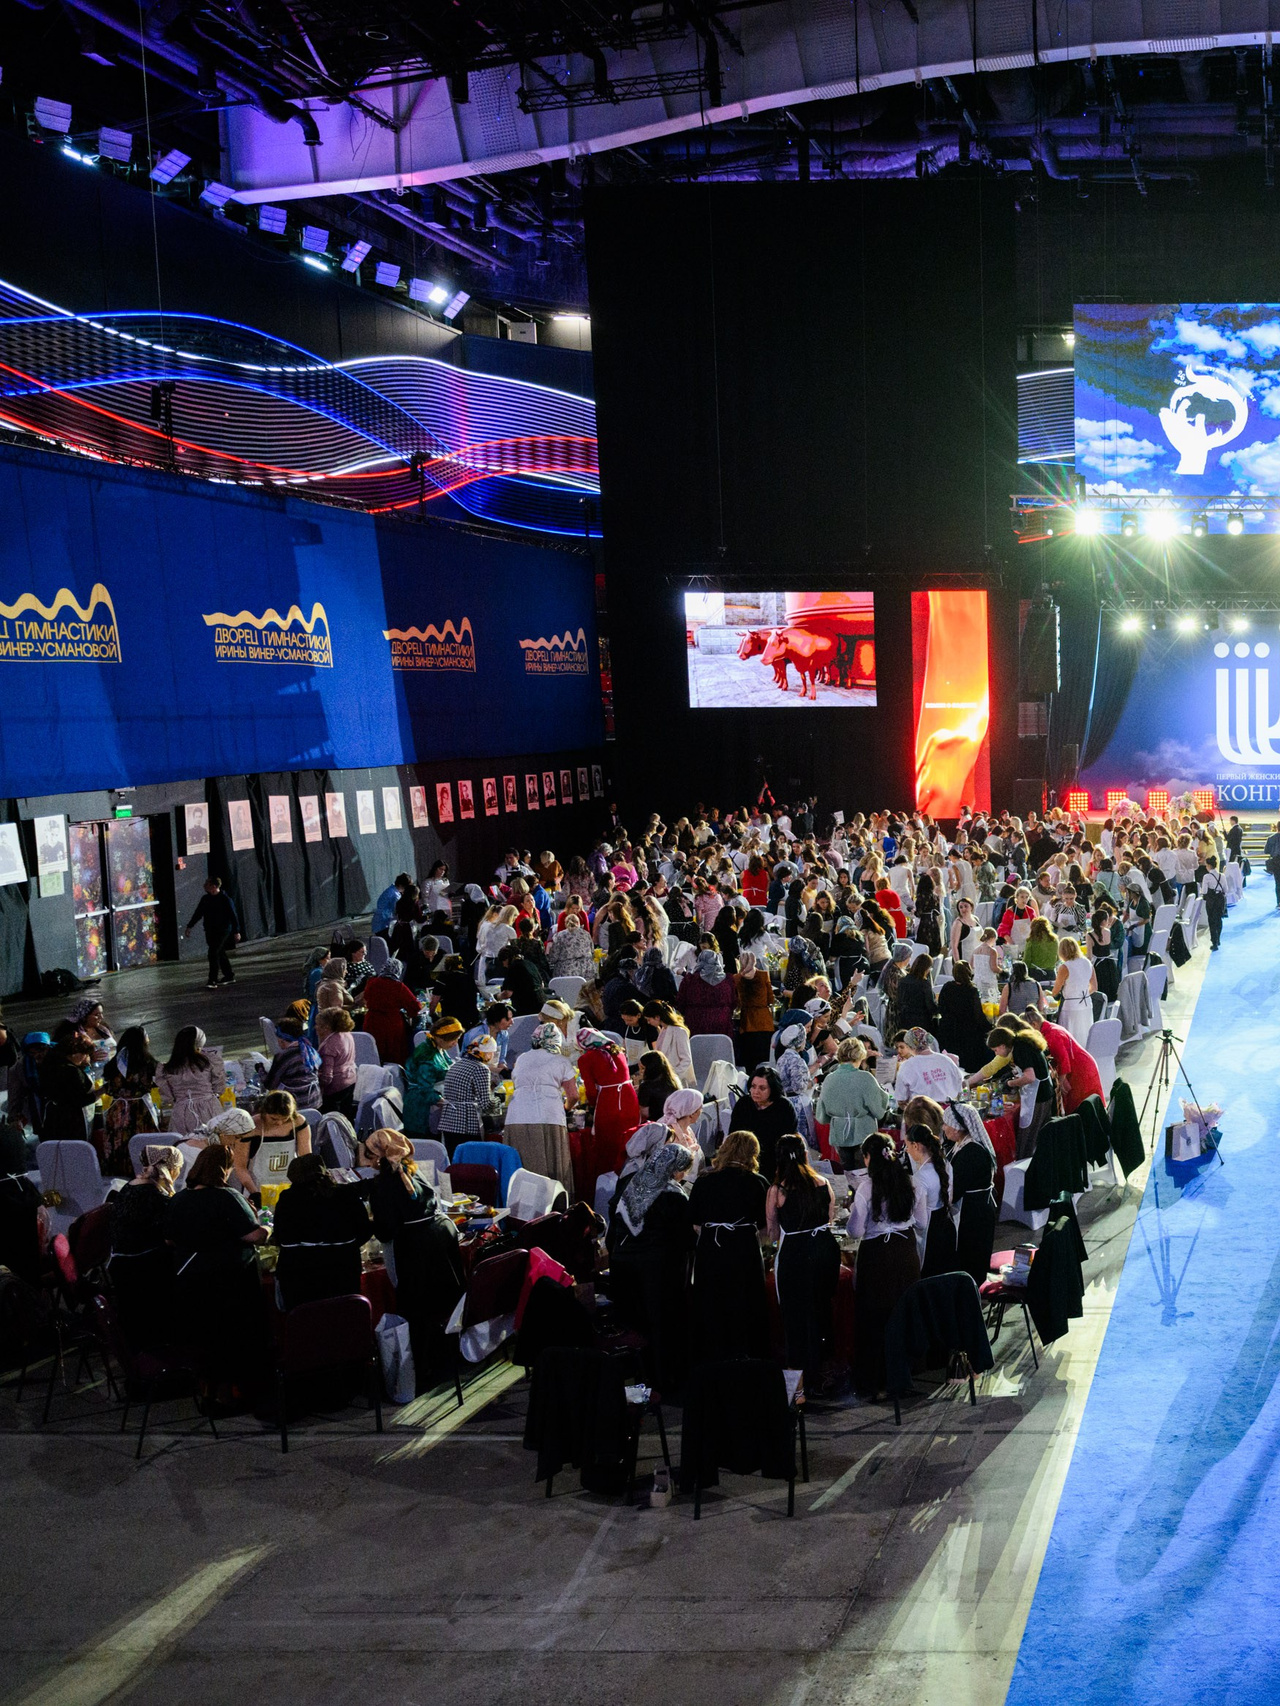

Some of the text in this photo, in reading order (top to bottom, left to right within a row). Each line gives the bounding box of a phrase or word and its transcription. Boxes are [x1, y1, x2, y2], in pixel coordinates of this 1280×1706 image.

[15, 621, 117, 642] ГИМНАСТИКИ
[214, 627, 330, 651] ДВОРЕЦ ГИМНАСТИКИ
[0, 641, 118, 659] ИНЕР-УСМАНОВОЙ
[215, 645, 331, 664] ИРИНЫ ВИНЕР-УСМАНОВОЙ
[391, 641, 474, 658] ДВОРЕЦ ГИМНАСТИКИ
[391, 655, 415, 667] ИРИНЫ
[1216, 772, 1247, 780] ПЕРВЫЙ
